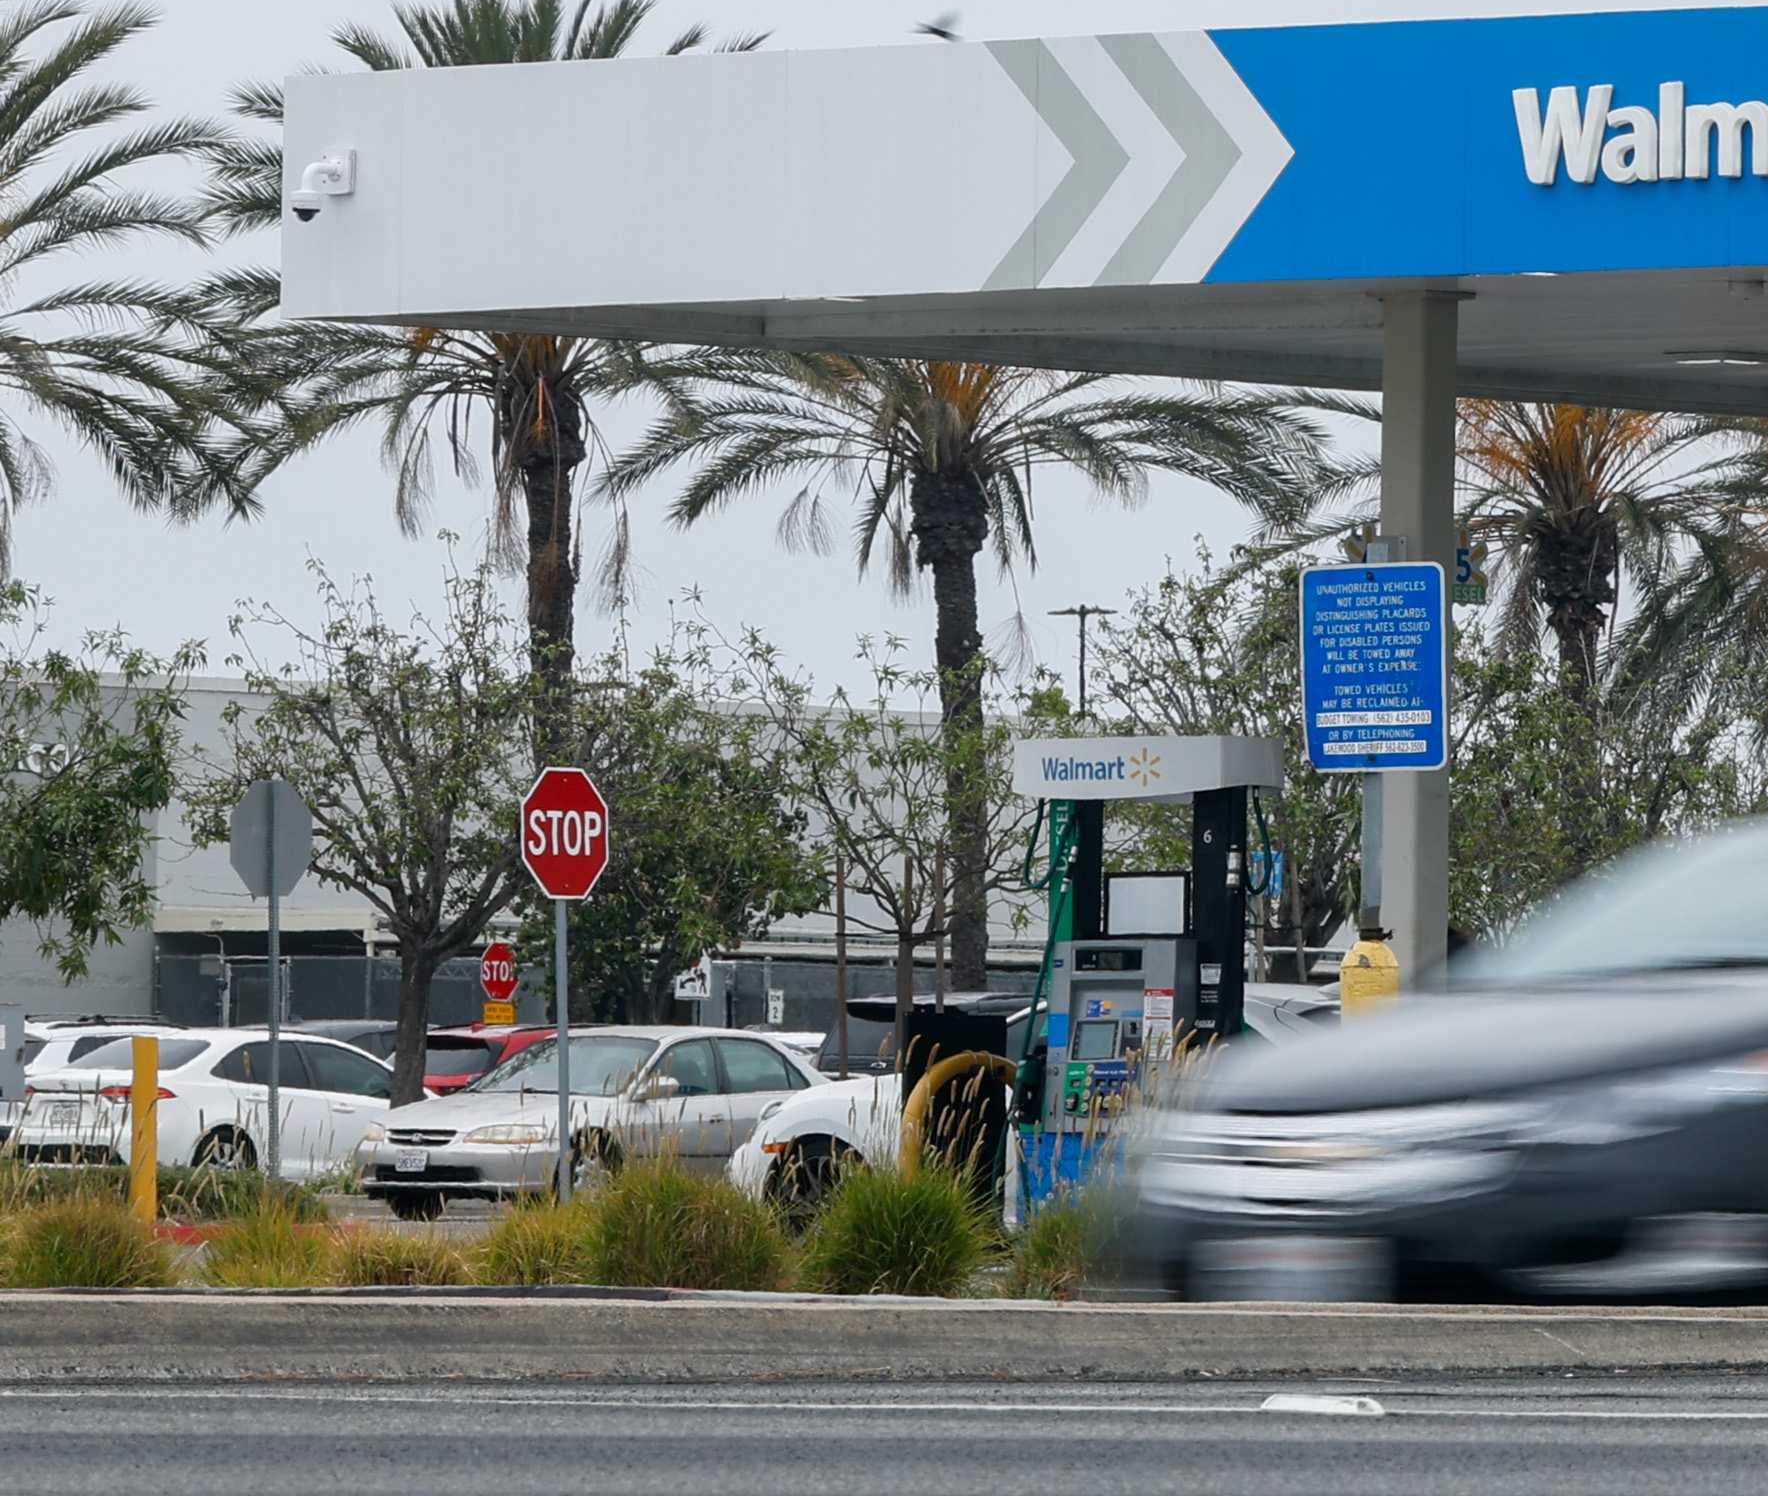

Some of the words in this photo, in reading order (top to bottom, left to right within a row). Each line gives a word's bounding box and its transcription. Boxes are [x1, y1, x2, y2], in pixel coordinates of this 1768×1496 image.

[1456, 548, 1471, 582] 5
[1316, 583, 1379, 595] UNAUTHORIZED
[1383, 581, 1426, 592] VEHICLES
[1337, 597, 1351, 607] NOT
[1356, 595, 1403, 606] DISPLAYING
[1382, 608, 1427, 618] PLACARDS
[1313, 625, 1323, 636] OR
[1327, 624, 1360, 634] LICENSE
[1365, 622, 1395, 632] PLATES
[1399, 621, 1430, 632] ISSUED
[1320, 638, 1335, 648] FOR
[1339, 636, 1378, 647] DISABLED
[1382, 634, 1422, 645] PERSONS
[1326, 651, 1344, 661] WILL
[1348, 650, 1358, 660] BE
[1363, 649, 1390, 659] TOWED
[1394, 648, 1415, 658] AWAY
[1321, 664, 1331, 674] AT
[1334, 685, 1361, 696] TOWED
[1366, 683, 1408, 694] VEHICLES
[1322, 699, 1337, 709] MAY
[1341, 698, 1352, 708] BE
[1357, 697, 1409, 708] RECLAIMED
[1329, 731, 1339, 741] OR
[1343, 730, 1353, 740] BY
[1358, 729, 1415, 740] TELEPHONING
[1042, 756, 1125, 781] Walmart
[528, 810, 602, 857] STOP
[1056, 802, 1069, 872] DSEL
[1203, 829, 1212, 844] 6
